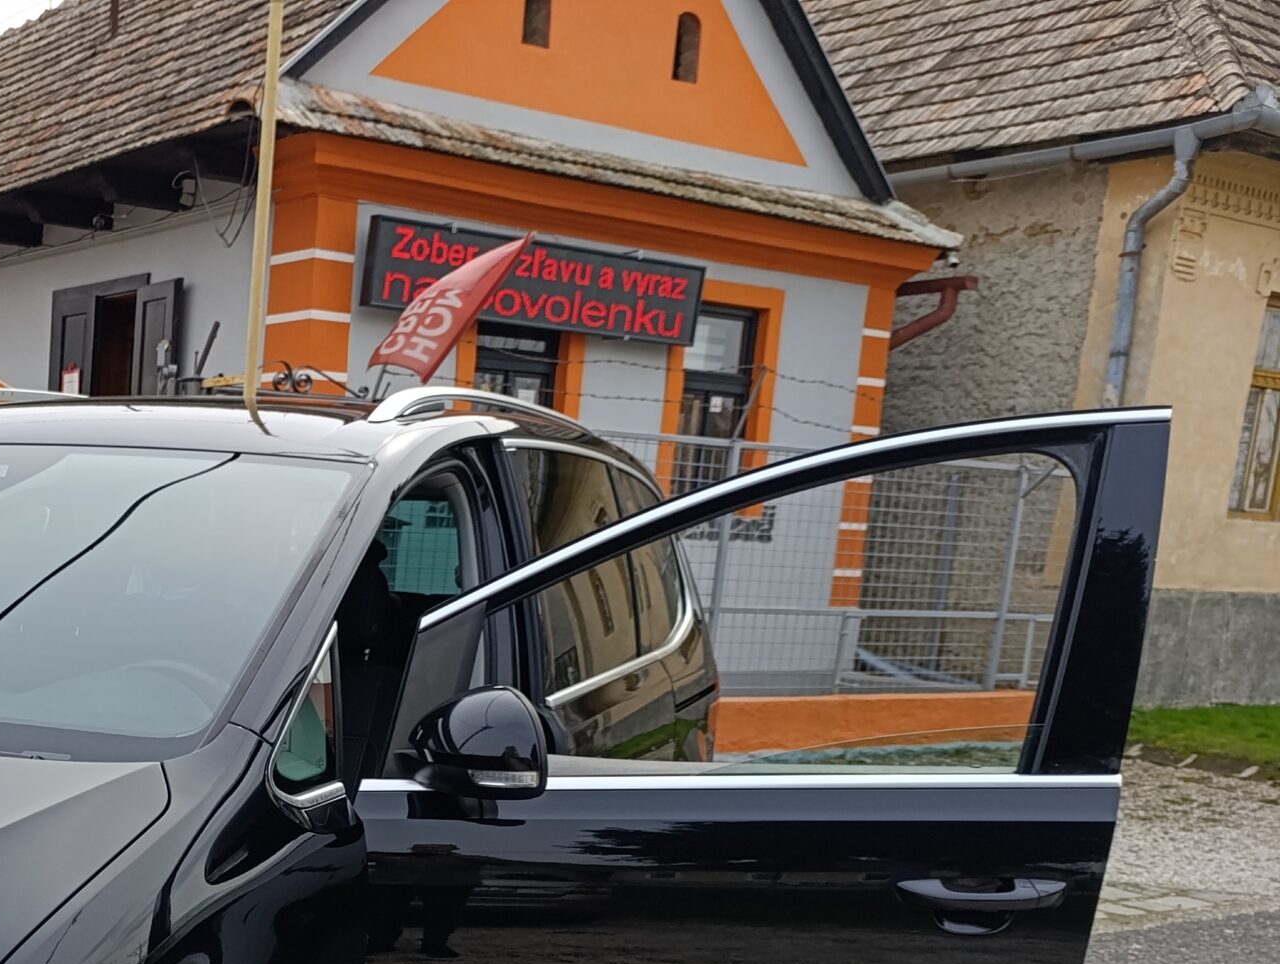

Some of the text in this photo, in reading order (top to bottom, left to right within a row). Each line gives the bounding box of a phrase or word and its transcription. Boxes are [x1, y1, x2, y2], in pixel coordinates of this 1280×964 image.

[598, 266, 615, 290] a
[622, 269, 689, 300] vyraz
[483, 287, 684, 339] ovolenku
